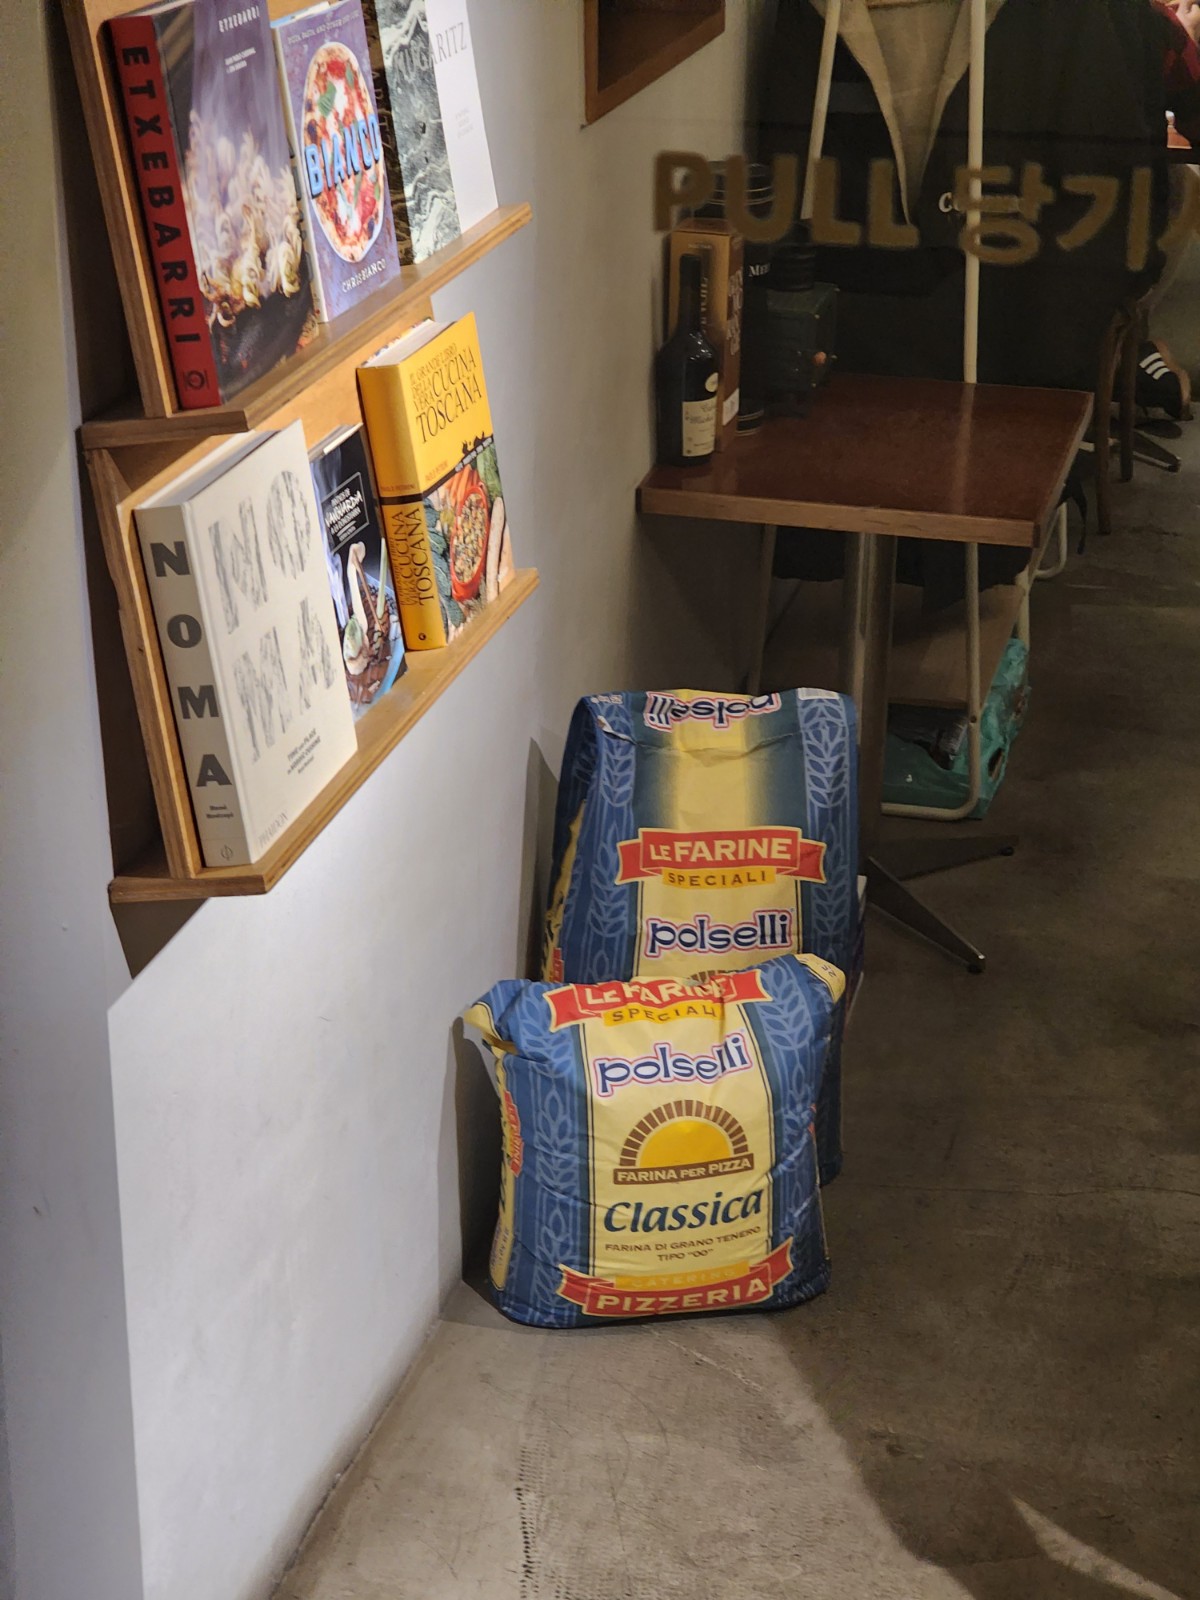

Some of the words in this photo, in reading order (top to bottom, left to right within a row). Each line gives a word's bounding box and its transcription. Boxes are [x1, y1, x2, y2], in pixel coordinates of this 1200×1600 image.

[305, 113, 382, 199] BIANCO
[122, 46, 202, 344] ETXEBARRI
[653, 151, 920, 246] PULL
[361, 258, 387, 282] BIANCO
[431, 347, 477, 398] CUCINA
[416, 373, 482, 444] TOSCANA
[392, 511, 415, 580] CUCINA
[405, 507, 435, 606] TOSCANA
[150, 541, 232, 787] NOMA
[645, 692, 780, 732] polselli
[650, 843, 672, 861] LE
[674, 837, 792, 862] FARINE
[668, 870, 767, 887] SPECIALI
[647, 911, 790, 956] polselli
[584, 987, 620, 1005] LE
[623, 976, 729, 1005] FARINE
[611, 1004, 718, 1023] SPECIALI
[596, 1035, 750, 1094] polselli
[616, 1169, 678, 1183] FARINA
[679, 1167, 706, 1179] PER
[708, 1157, 752, 1175] PIZZA
[603, 1188, 765, 1234] Classica
[605, 1243, 652, 1253] FARINA
[654, 1241, 668, 1251] DI
[670, 1237, 714, 1250] GRANO
[716, 1226, 761, 1243] TENERO
[657, 1250, 685, 1263] TIPO
[596, 1278, 768, 1312] PIZZERIA
[630, 1267, 738, 1289] CATERING
